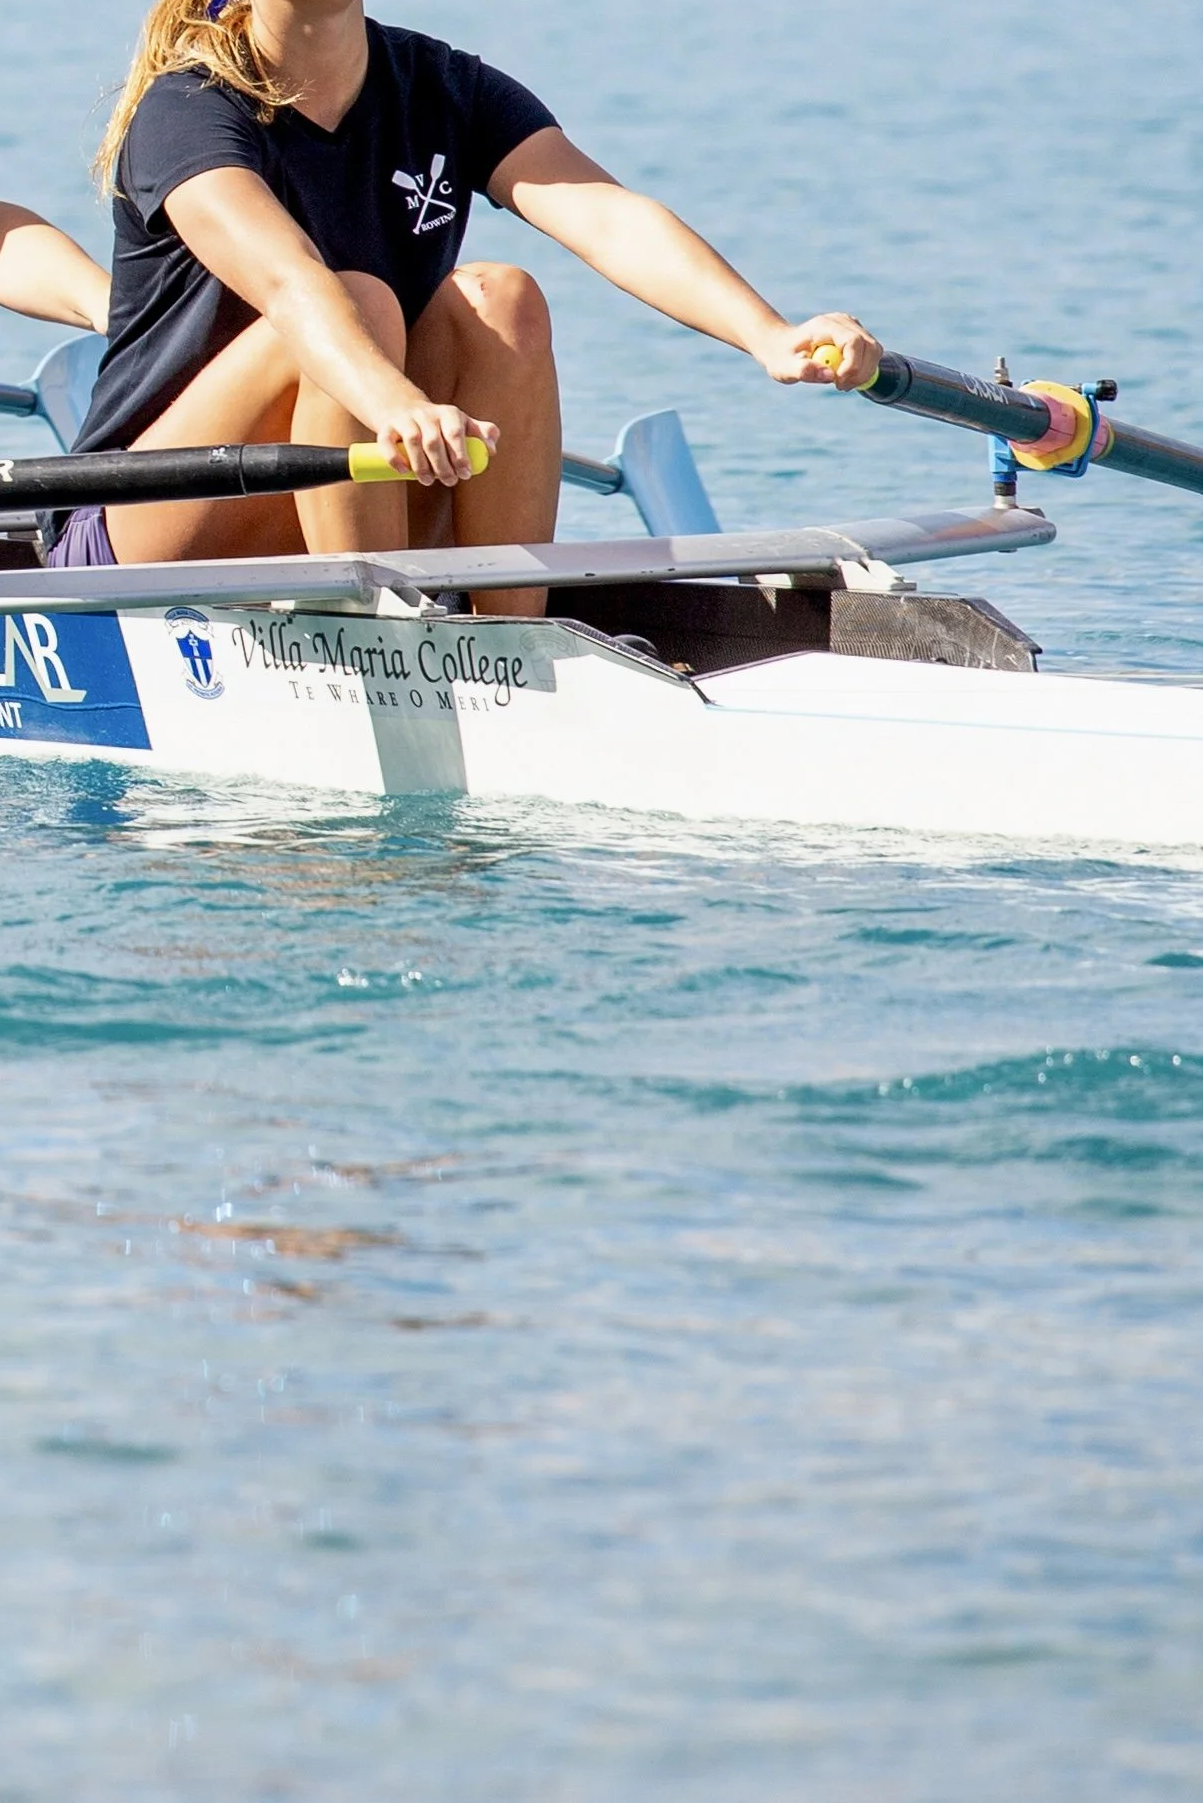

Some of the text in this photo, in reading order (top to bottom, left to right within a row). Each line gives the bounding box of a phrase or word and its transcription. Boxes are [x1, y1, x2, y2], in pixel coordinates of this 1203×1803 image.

[415, 173, 424, 187] V
[439, 180, 453, 195] C
[405, 195, 420, 210] M
[232, 619, 528, 706] Villa Maria College
[409, 688, 424, 708] O
